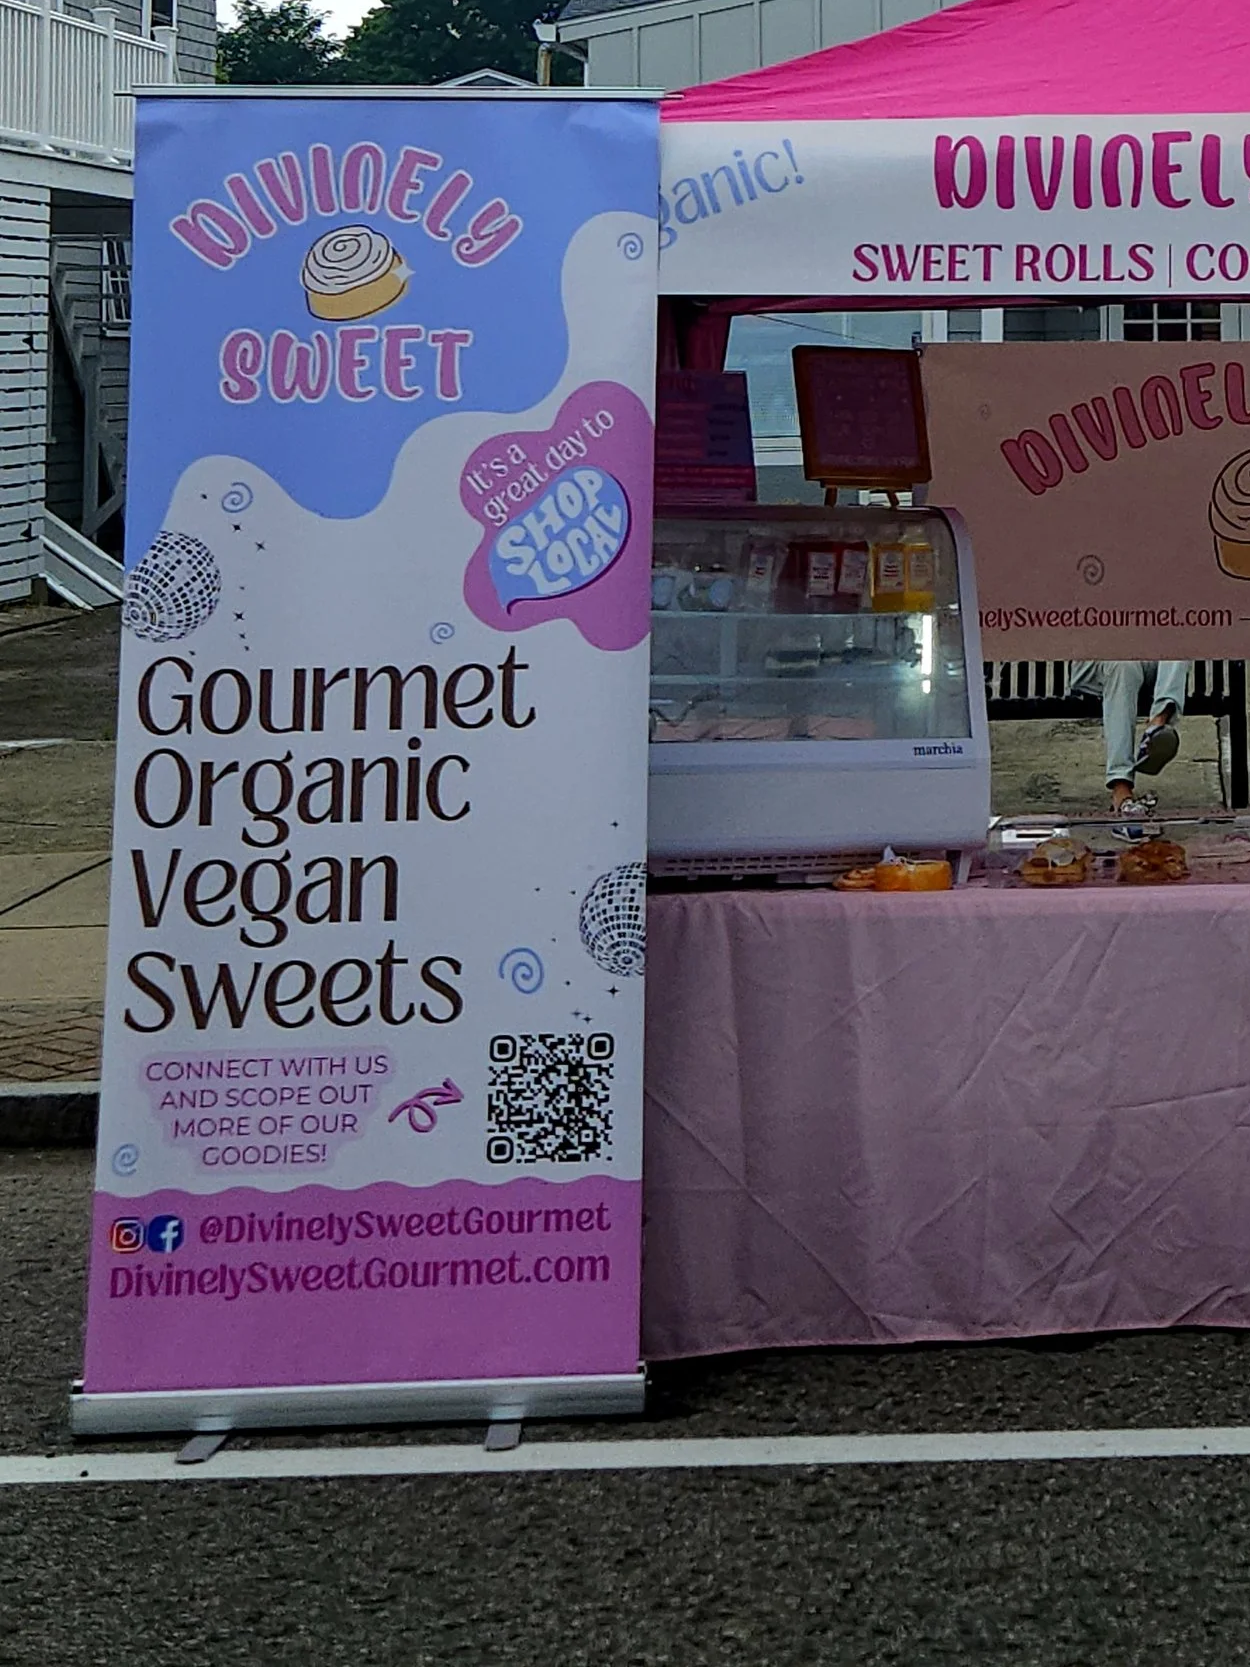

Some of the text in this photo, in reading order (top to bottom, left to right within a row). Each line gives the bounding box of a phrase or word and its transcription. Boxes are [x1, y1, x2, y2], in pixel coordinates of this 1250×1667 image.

[171, 142, 523, 270] DIVINELY
[852, 244, 1002, 282] SWEET
[1015, 243, 1155, 282] ROLLS
[219, 325, 473, 403] SWEET
[466, 443, 527, 495] It's a
[483, 410, 614, 526] great day to
[496, 470, 603, 575] SHOP
[527, 504, 622, 594] LOCAL
[137, 644, 537, 737] Gourmet
[133, 736, 471, 848] Organic
[130, 845, 399, 949] Vegan
[122, 940, 465, 1033] Sweets
[146, 1054, 389, 1082] CONNECT WITH US
[160, 1084, 373, 1110] AND SCOPE OUT
[173, 1113, 358, 1139] MORE OF OUR
[202, 1144, 327, 1166] GOODIES!
[200, 1201, 612, 1246] @DivinelySweetGourmet
[109, 1250, 611, 1301] DivinelySweetGourmet.com
